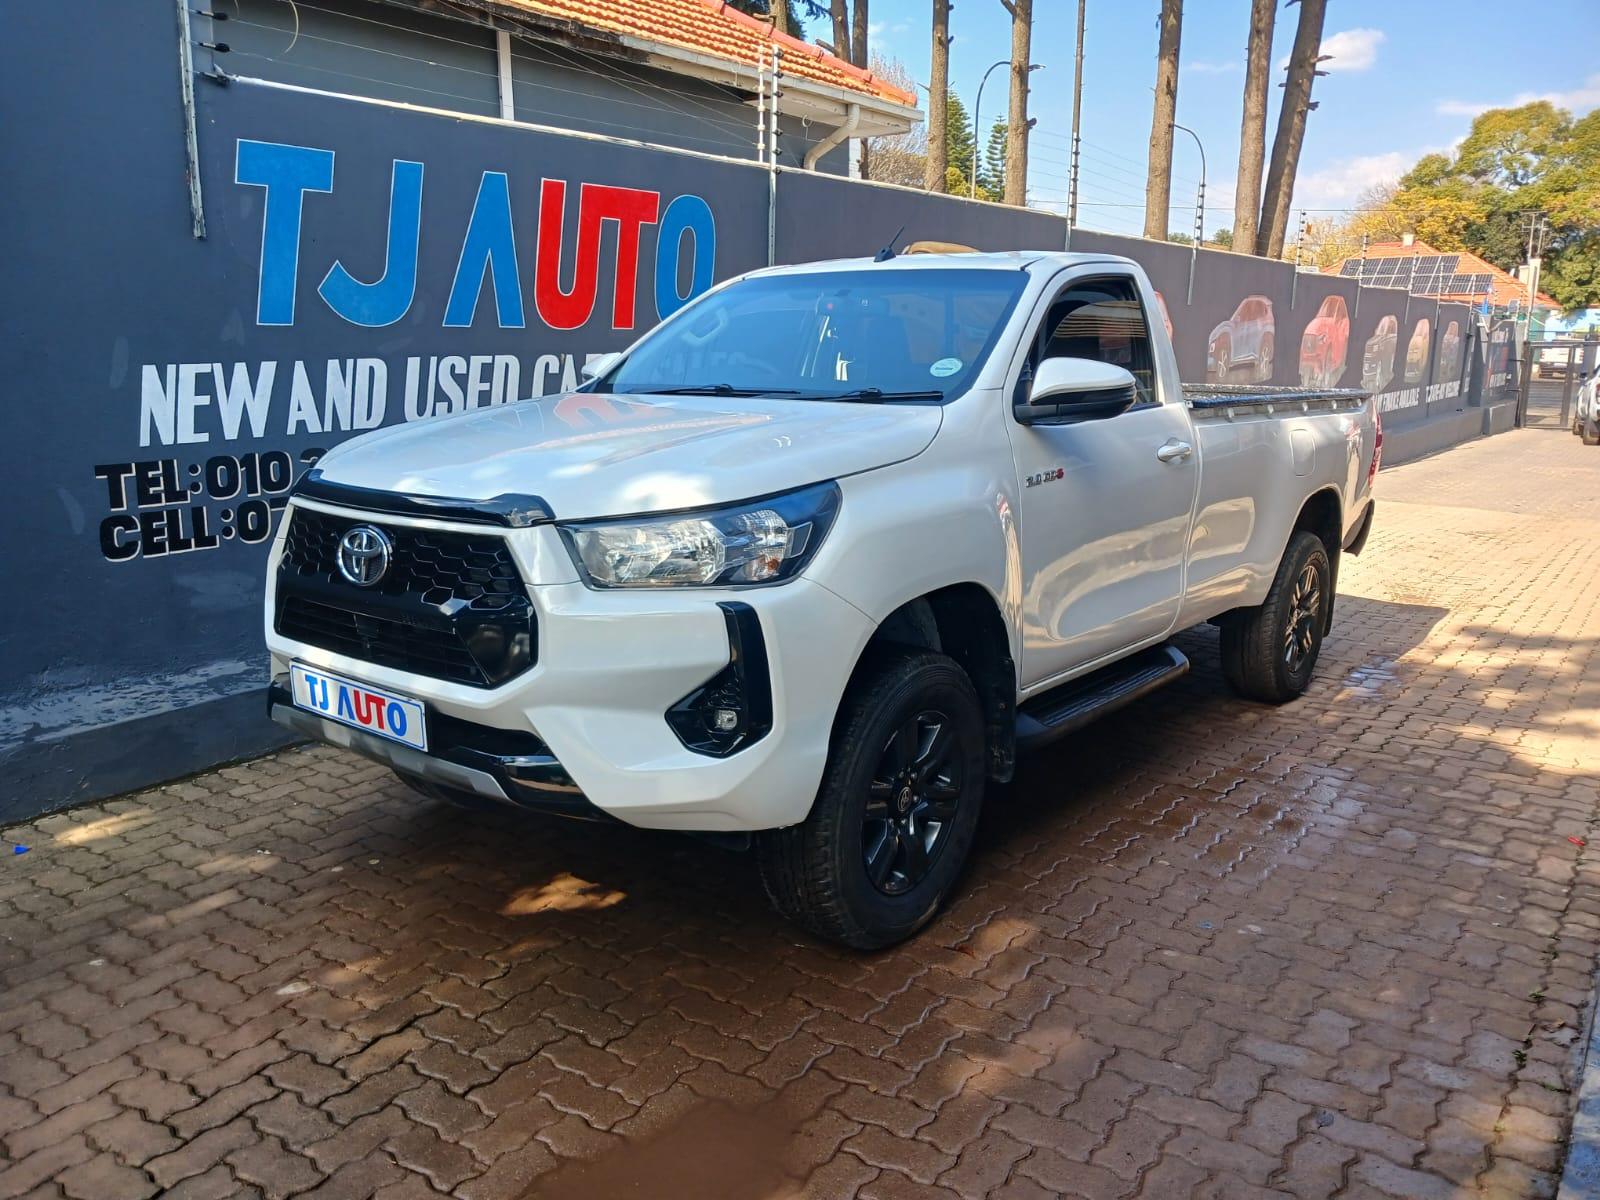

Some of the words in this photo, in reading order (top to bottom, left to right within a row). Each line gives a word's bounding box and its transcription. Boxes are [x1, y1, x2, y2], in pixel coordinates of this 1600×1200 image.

[235, 138, 424, 328] TJ
[442, 170, 716, 330] AUTO
[139, 360, 278, 447] NEW
[287, 357, 389, 435] AND
[404, 354, 521, 421] USED
[532, 354, 604, 399] CA
[305, 674, 329, 711] TJ
[338, 685, 408, 737] AUTO
